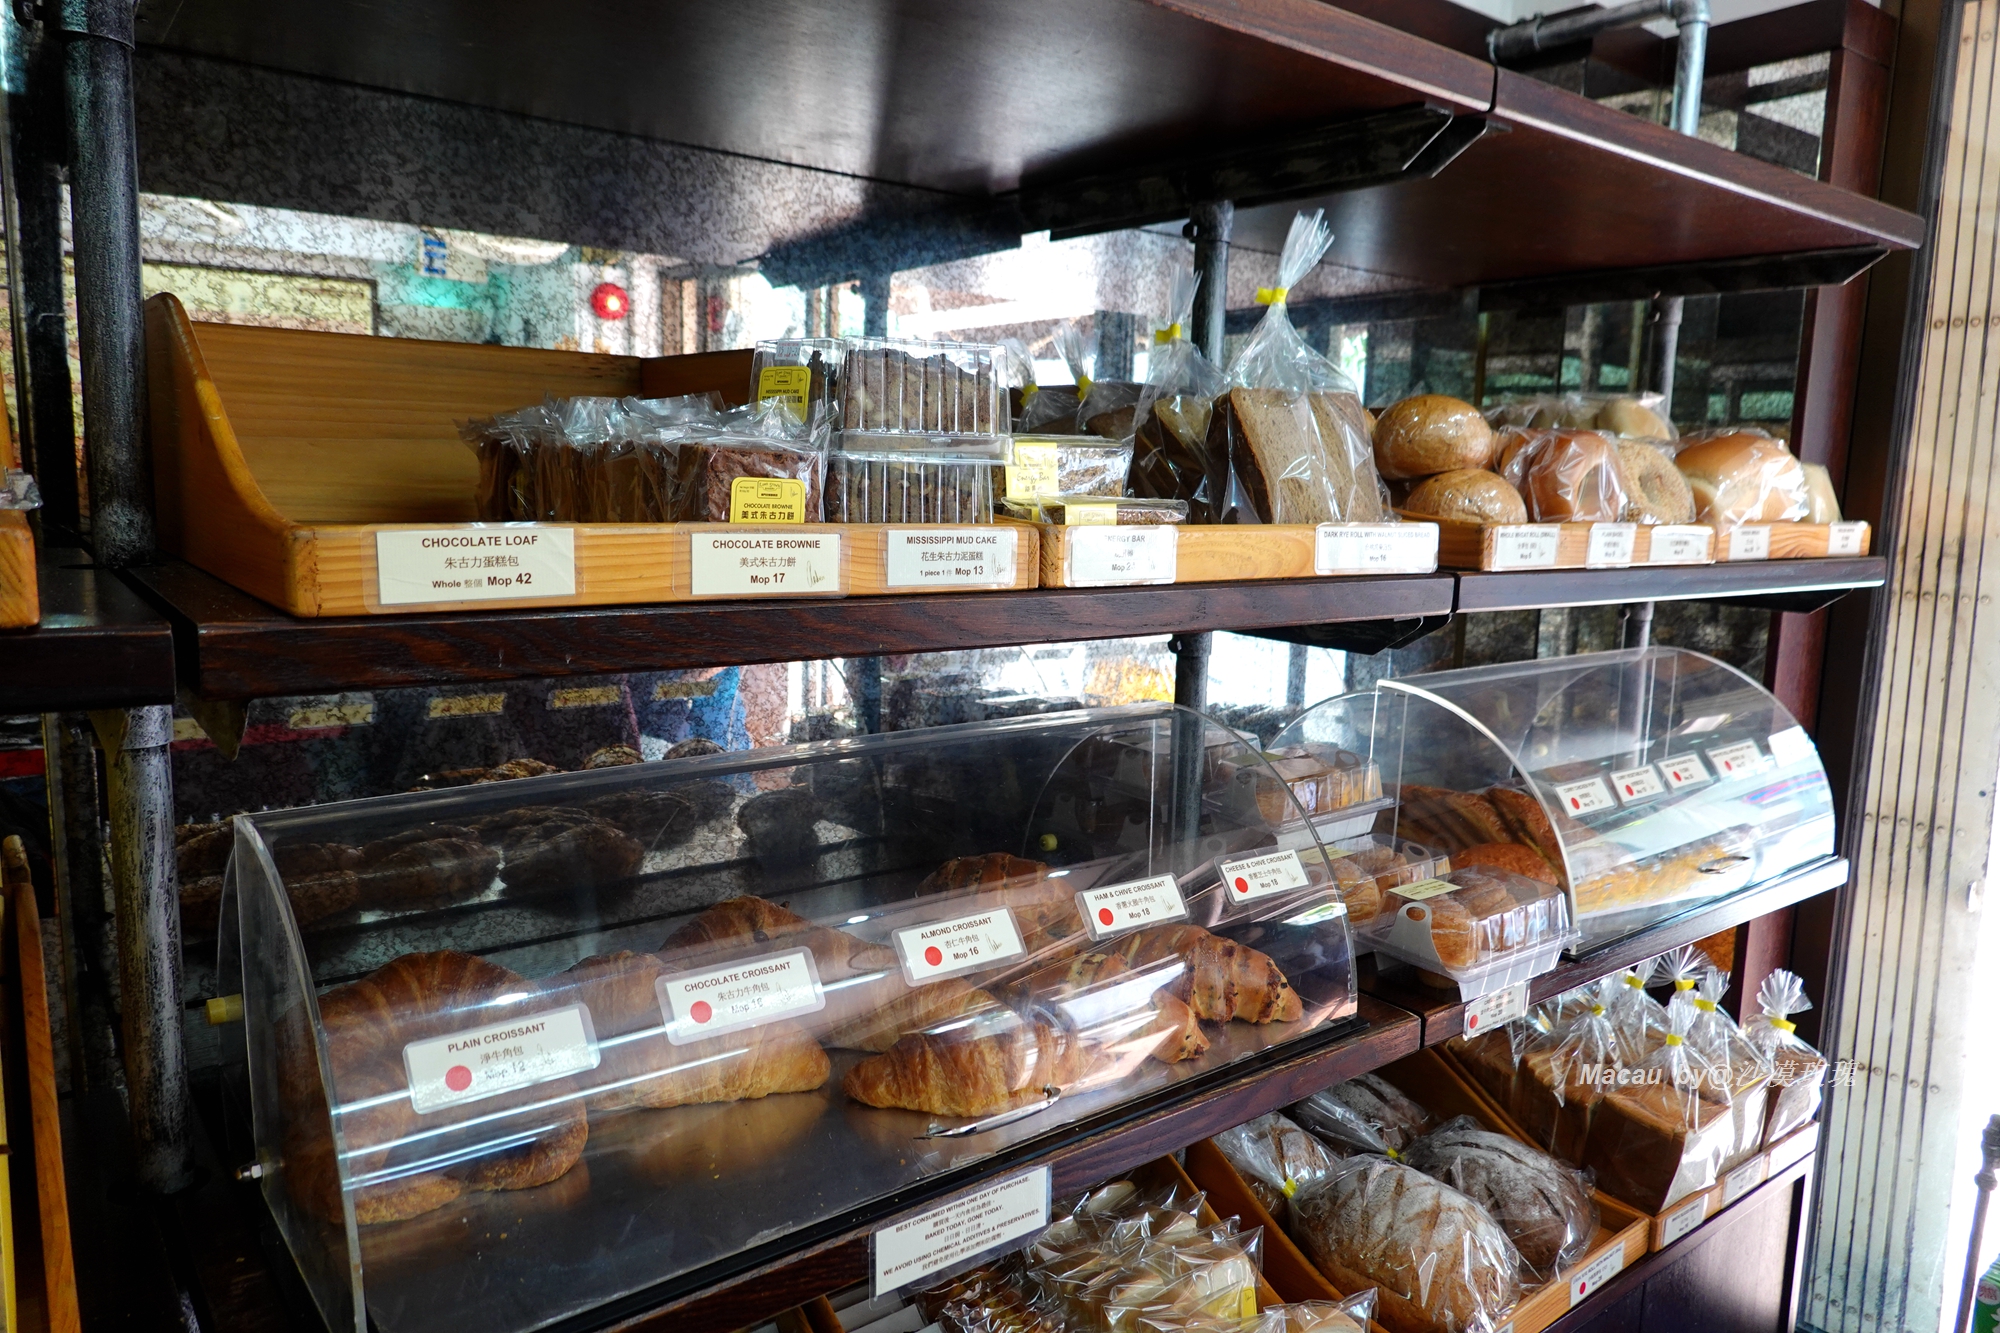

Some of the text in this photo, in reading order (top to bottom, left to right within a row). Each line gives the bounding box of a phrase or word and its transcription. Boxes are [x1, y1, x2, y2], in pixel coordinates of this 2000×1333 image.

[741, 511, 794, 520] 美式朱古力餅
[421, 535, 538, 548] CHOCOLATE LOAF
[712, 540, 821, 549] CHOCOLATE BROWNIE
[906, 536, 997, 545] MISSISSIPPI MUD CAKE
[1131, 535, 1146, 543] BAR
[444, 555, 519, 569] 朱古力蛋糕包
[740, 557, 796, 568] 美式朱古力餅
[921, 551, 984, 561] 花生朱古力泥蛋糕
[955, 567, 971, 576] Mop
[973, 565, 984, 575] 13
[1111, 564, 1125, 572] Mop
[432, 572, 532, 588] Whole 整個 Mop 42
[750, 573, 785, 585] Mop 17
[1225, 864, 1246, 873] CHEESE
[1250, 859, 1267, 868] CHIVE
[1266, 853, 1294, 865] CROISSANT
[1094, 893, 1108, 901] HAM
[1114, 887, 1133, 897] CHIVE
[1133, 881, 1166, 893] CROISSANT
[1129, 908, 1151, 919] Mop 18
[920, 917, 992, 940] ALMOND CROISSANT
[944, 934, 980, 949] 杏仁牛角包
[953, 946, 979, 960] Mop 16
[684, 961, 791, 993] CHOCOLATE CROISSANT
[717, 982, 771, 1002] 朱古力牛角包
[447, 1022, 546, 1053] PLAIN CROISSANT
[479, 1045, 525, 1065] 淨牛角包
[895, 1177, 1030, 1233] BEST CONSUMED WITHIN ONE DAY OF PURCHASE.
[925, 1228, 945, 1240] BAKED
[967, 1212, 983, 1223] GONE
[883, 1267, 894, 1276] WE
[894, 1260, 913, 1272] AVOID
[913, 1253, 932, 1265] USING
[932, 1240, 961, 1256] CHEMICAL
[962, 1229, 990, 1244] ADDITIVES
[996, 1208, 1040, 1231] PRESERVATIVES.
